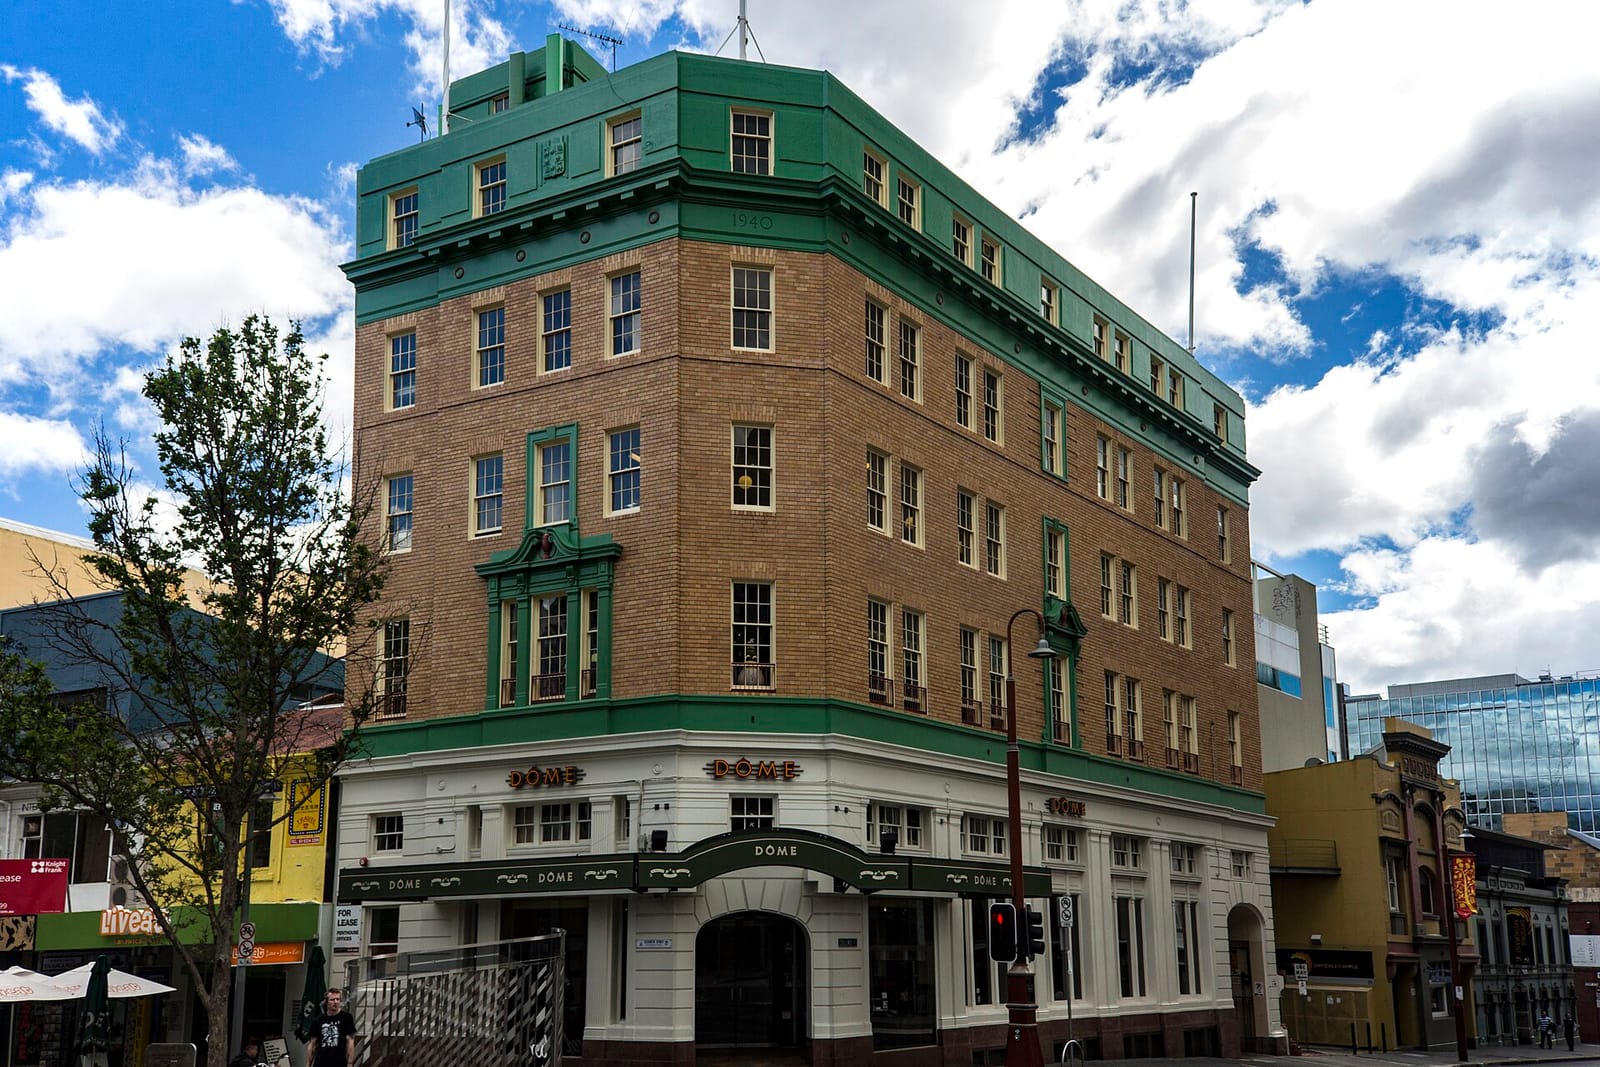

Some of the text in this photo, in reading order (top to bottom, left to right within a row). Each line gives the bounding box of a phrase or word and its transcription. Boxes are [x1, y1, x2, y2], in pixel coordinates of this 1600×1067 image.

[733, 214, 773, 230] 1940
[755, 844, 797, 856] DÔME
[45, 861, 67, 869] Knight
[538, 871, 574, 884] DÔME
[388, 878, 421, 890] DÔME
[337, 909, 352, 917] FOR
[337, 918, 359, 927] LEASE
